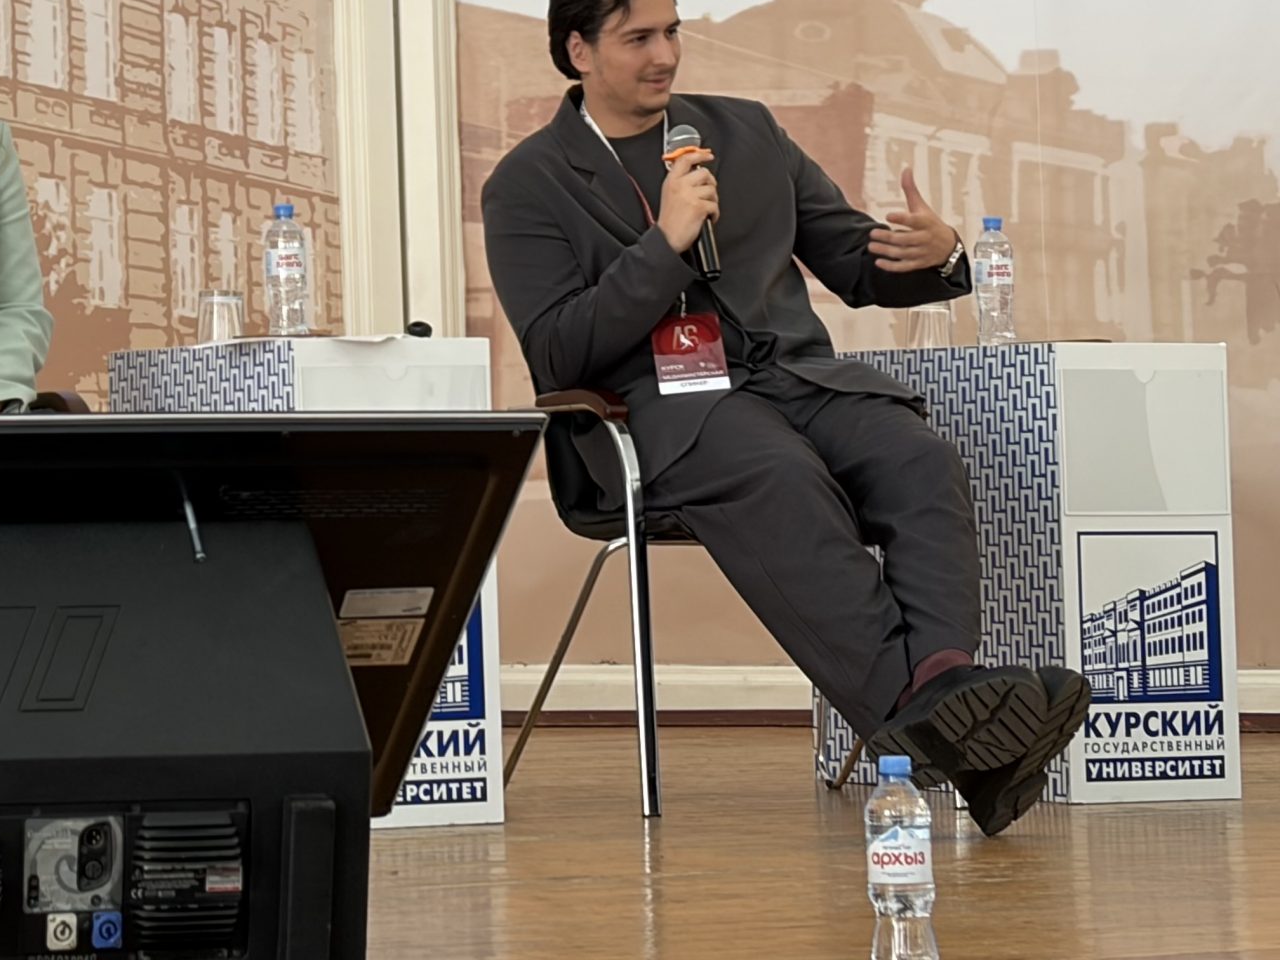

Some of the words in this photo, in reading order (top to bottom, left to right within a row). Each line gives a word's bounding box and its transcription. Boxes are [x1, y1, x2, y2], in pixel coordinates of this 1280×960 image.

[1084, 703, 1224, 738] КУРСКИЙ
[1084, 737, 1225, 755] ГОСУДАРСТВЕННЫЙ
[1088, 759, 1223, 779] УНИВЕРСИТЕТ
